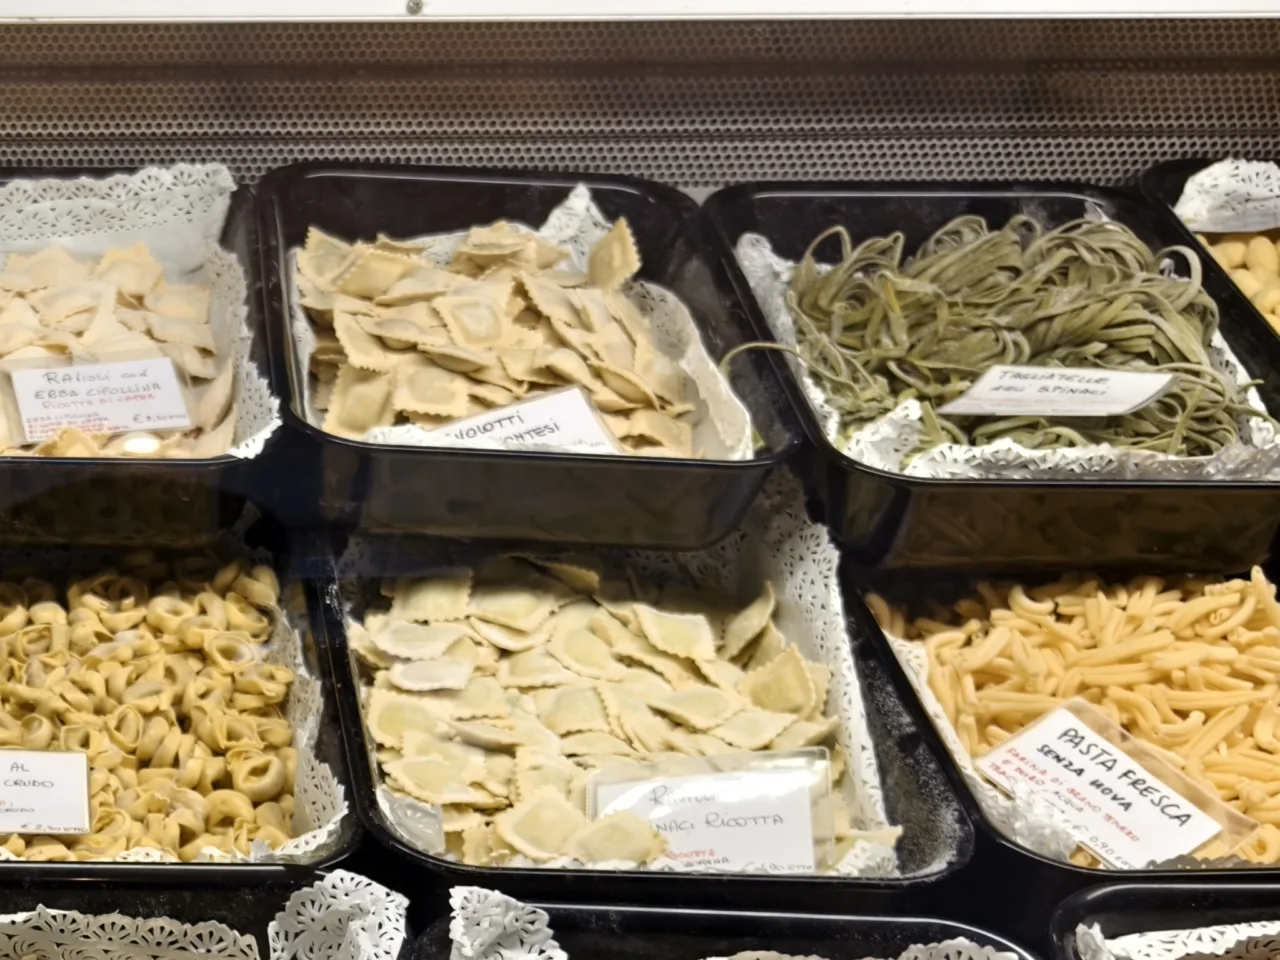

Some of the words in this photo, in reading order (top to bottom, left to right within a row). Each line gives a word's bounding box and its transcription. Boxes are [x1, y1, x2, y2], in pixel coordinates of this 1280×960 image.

[10, 762, 30, 772] AL
[4, 778, 54, 788] CRUDO
[1036, 743, 1085, 777] SENZA
[1089, 779, 1134, 812] UOVA
[1057, 728, 1120, 772] PASTA
[1117, 769, 1192, 828] FRESCA
[705, 812, 784, 829] RICOTTA
